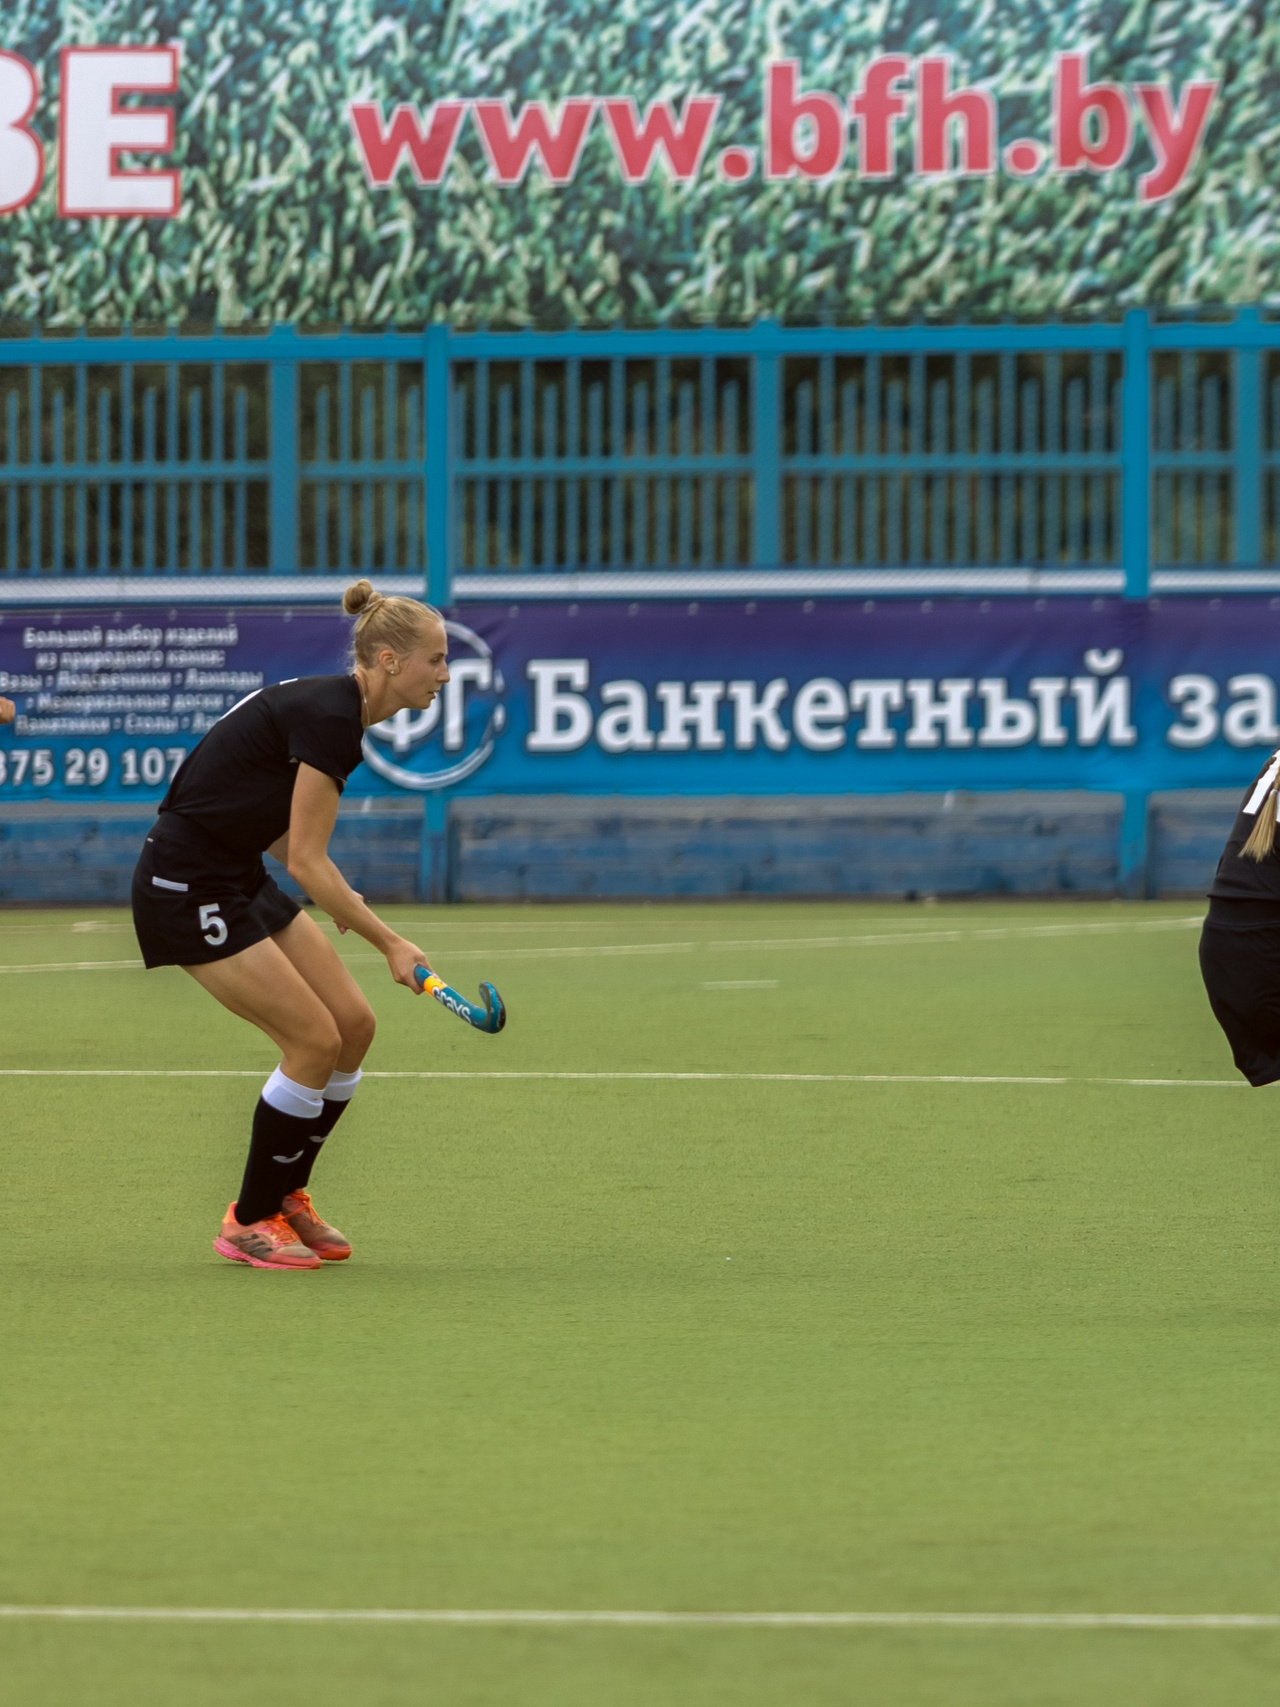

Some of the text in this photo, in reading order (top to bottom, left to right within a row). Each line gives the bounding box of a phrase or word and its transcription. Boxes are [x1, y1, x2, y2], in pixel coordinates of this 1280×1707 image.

[348, 52, 1220, 202] www.bfh.by
[526, 648, 1137, 752] Банкетный
[65, 748, 109, 786] 29
[198, 902, 228, 946] 5
